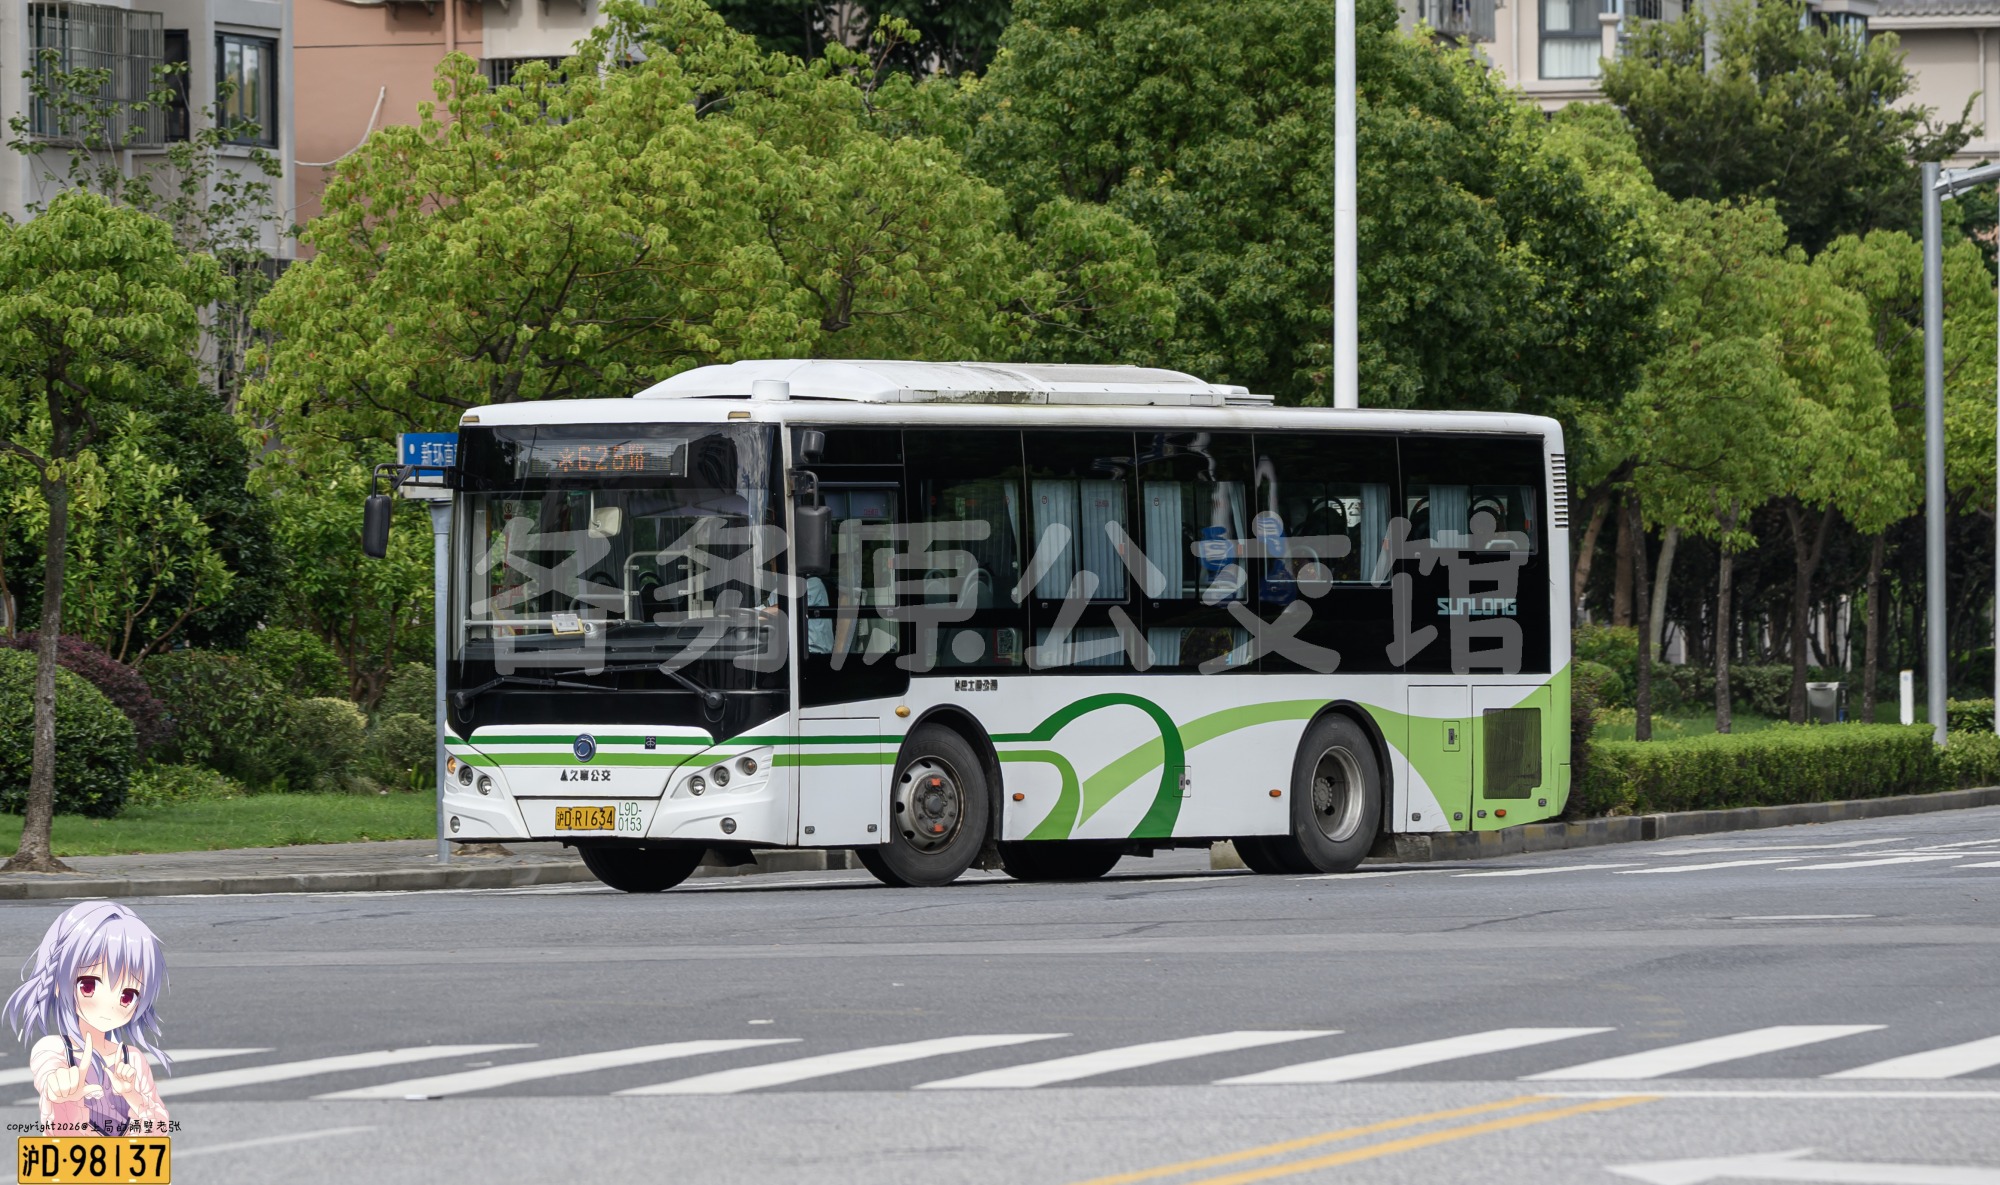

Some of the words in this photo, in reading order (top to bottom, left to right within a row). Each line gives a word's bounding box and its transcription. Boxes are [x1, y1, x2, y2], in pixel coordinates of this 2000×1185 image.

[1437, 598, 1517, 615] SUNLONG
[618, 802, 642, 816] L9D-
[618, 817, 642, 831] 0153
